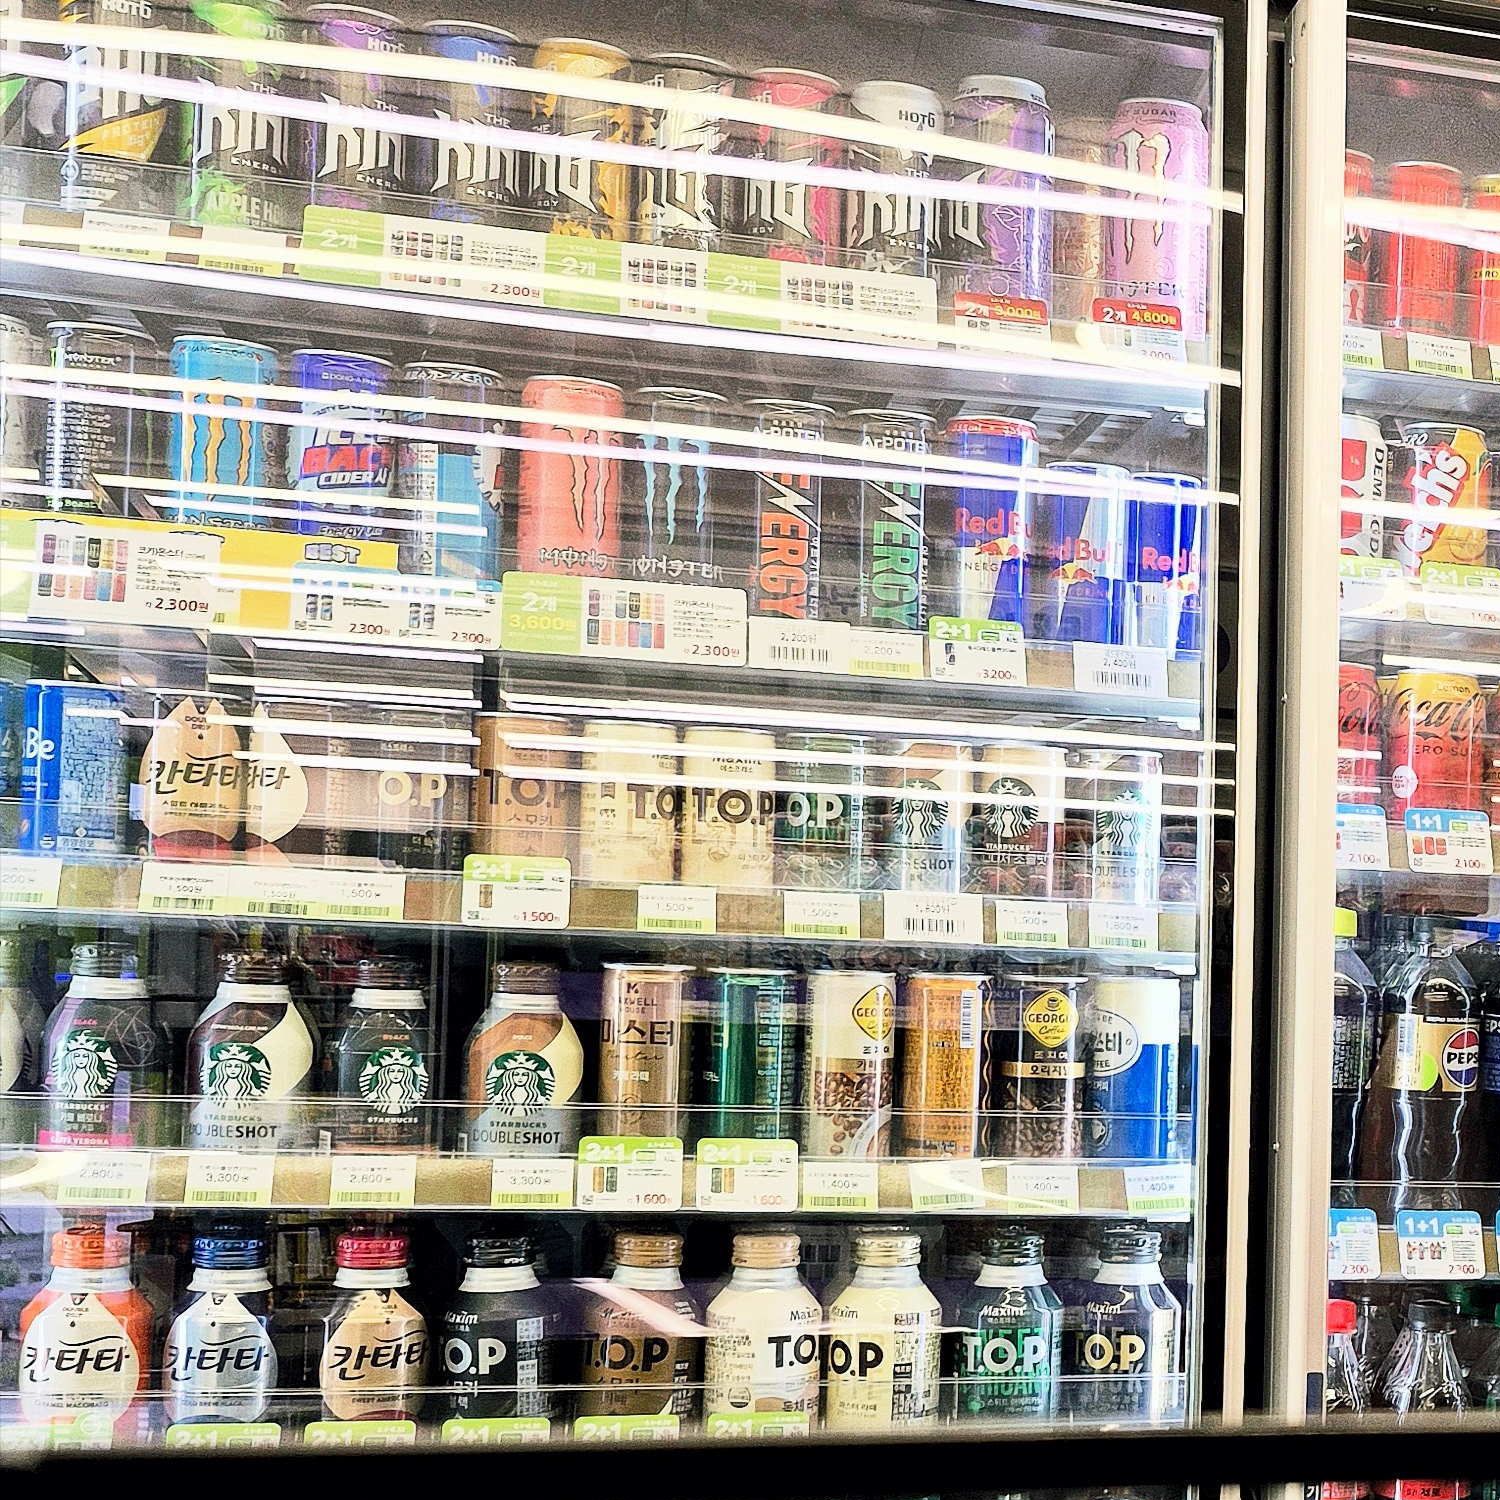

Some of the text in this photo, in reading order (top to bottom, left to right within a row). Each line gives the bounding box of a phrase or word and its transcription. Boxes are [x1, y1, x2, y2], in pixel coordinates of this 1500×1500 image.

[899, 109, 935, 128] HOT6
[1133, 108, 1177, 118] SUGAR
[322, 229, 358, 249] 2개
[561, 257, 596, 277] 2개
[723, 276, 757, 295] 2개
[964, 303, 989, 318] 2개
[1102, 306, 1127, 323] 2개
[304, 544, 360, 563] BEST
[1142, 547, 1186, 573] Red
[1426, 568, 1458, 585] 2+1
[521, 593, 557, 612] 2개
[935, 622, 971, 640] 2+1
[1437, 683, 1471, 694] Lemon
[1411, 814, 1442, 830] 1+1
[472, 862, 513, 880] 2+1
[55, 1102, 107, 1112] STARBUCKS
[204, 1114, 262, 1122] STARBUCKS
[367, 1116, 418, 1124] STARBUCKS
[490, 1121, 547, 1129] STARBUCKS
[473, 1129, 561, 1145] DOUBLESHOT
[585, 1143, 625, 1162] 2+1
[1404, 1217, 1439, 1235] 1+1
[981, 1303, 1026, 1317] Maxim
[165, 1345, 269, 1381] 칸타타
[329, 1340, 426, 1380] 칸타타
[964, 1335, 1046, 1373] T.O.P
[23, 1346, 130, 1382] 칸타타
